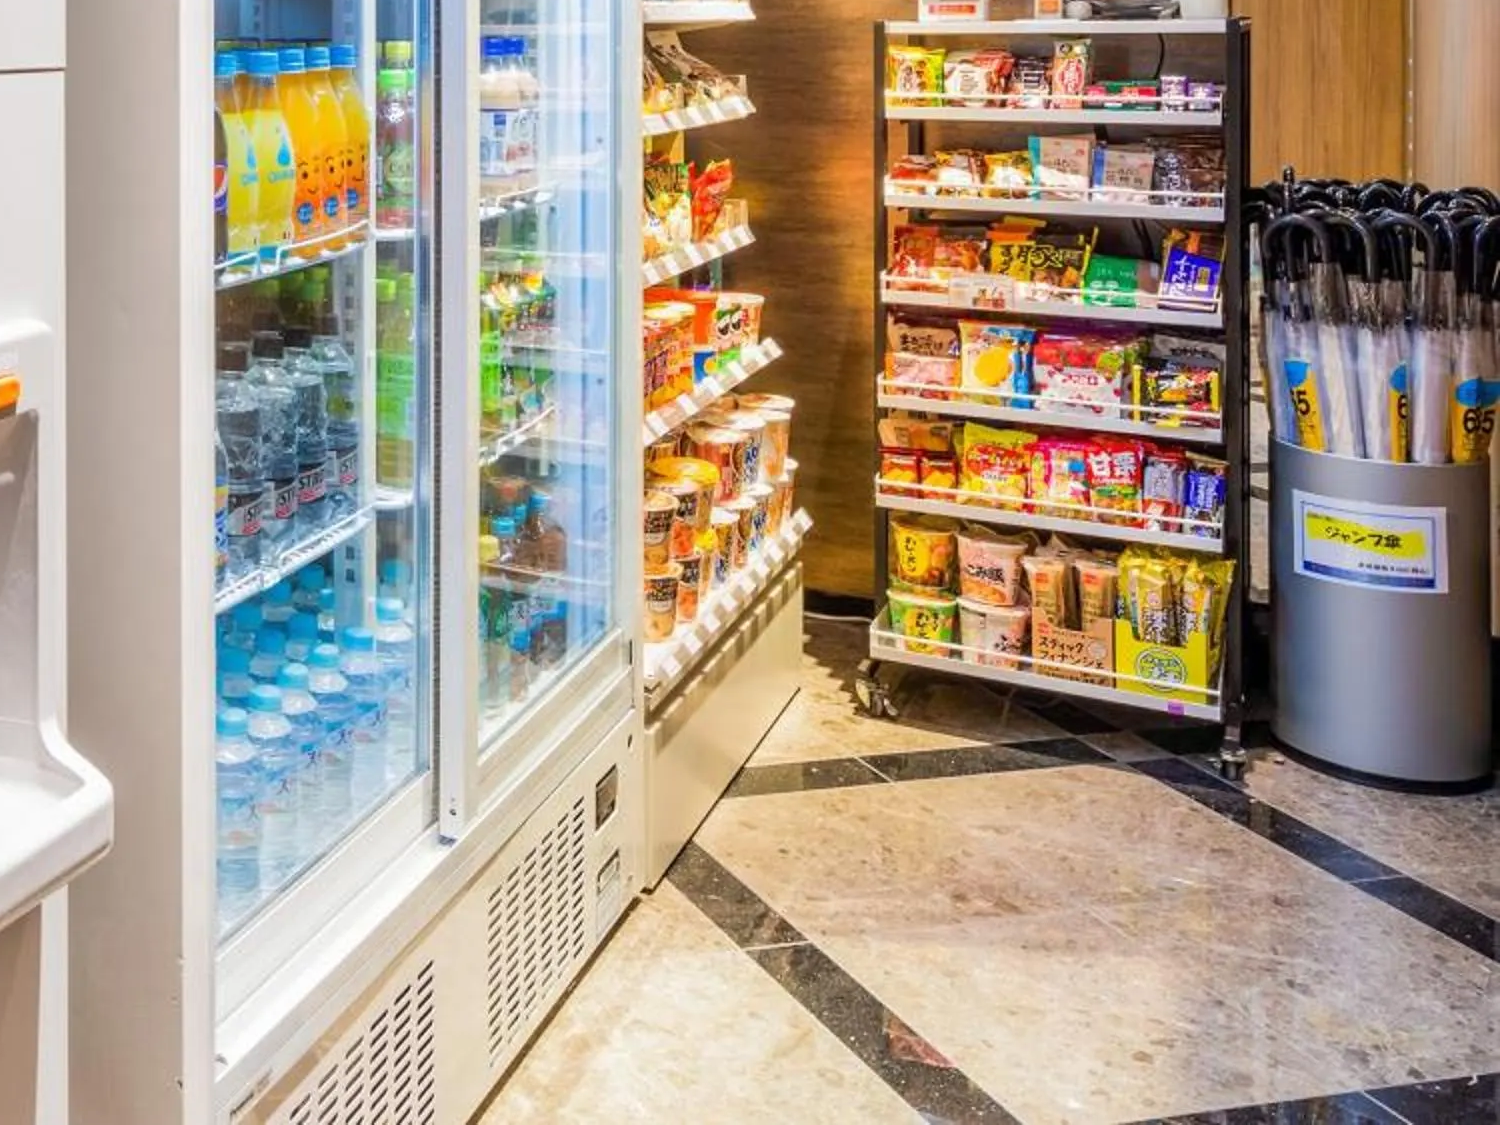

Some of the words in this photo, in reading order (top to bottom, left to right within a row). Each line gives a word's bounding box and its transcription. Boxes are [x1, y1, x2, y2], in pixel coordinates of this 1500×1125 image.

[1088, 451, 1138, 479] 甘栗
[1039, 636, 1084, 653] スティック
